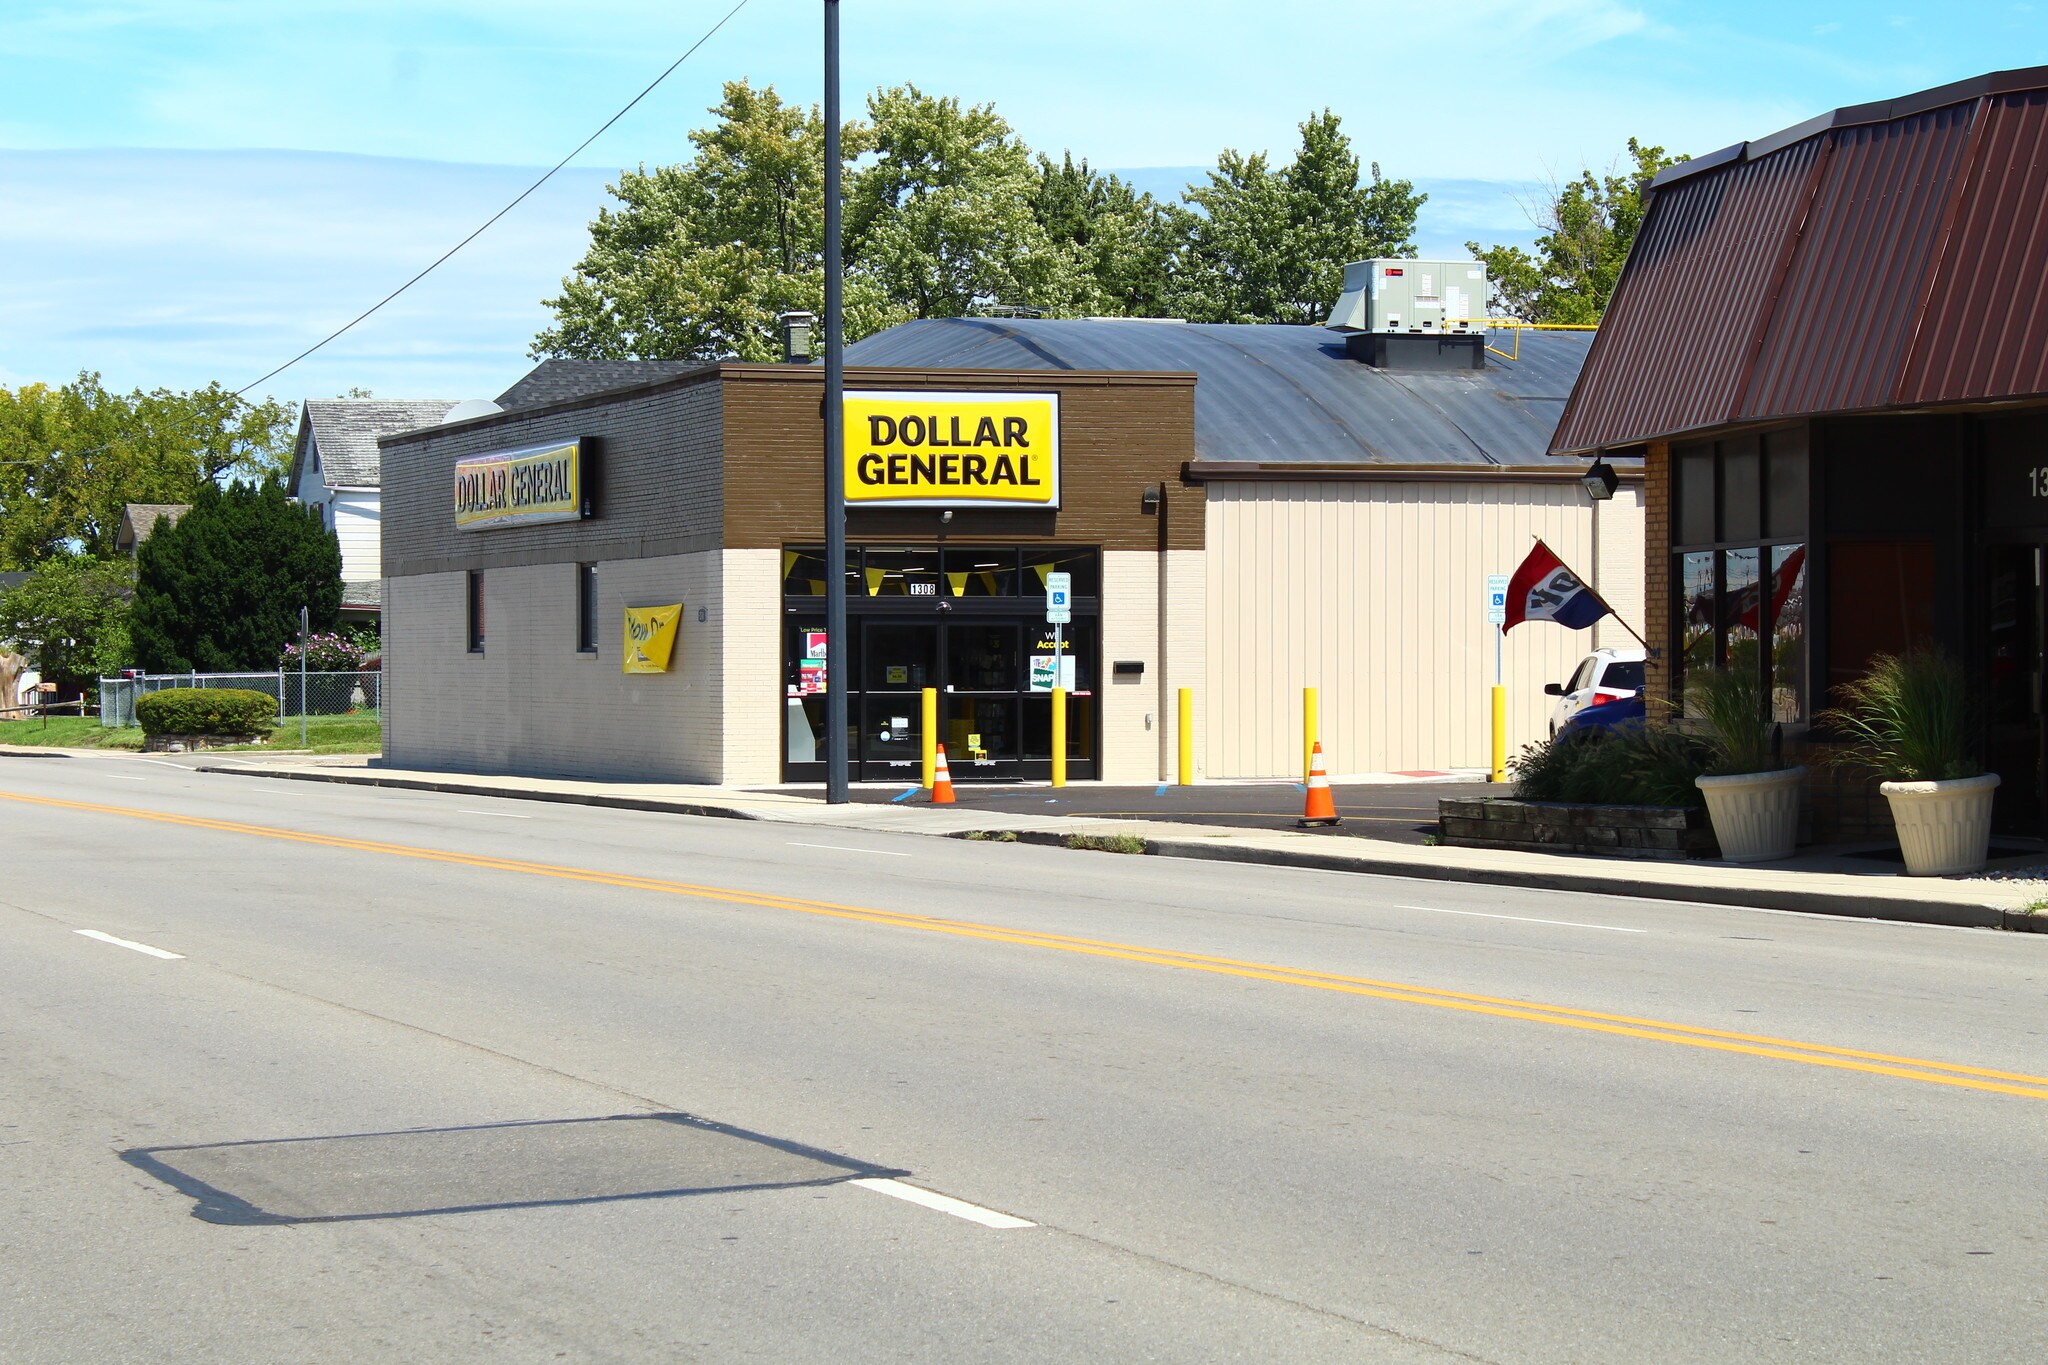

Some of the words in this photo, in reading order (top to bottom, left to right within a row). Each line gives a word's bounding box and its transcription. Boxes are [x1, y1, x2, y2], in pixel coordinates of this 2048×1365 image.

[867, 415, 1030, 447] DOLLAR
[857, 453, 1041, 486] GENERAL
[2029, 467, 2048, 497] 13
[457, 469, 507, 513] DOLLAR
[511, 459, 572, 507] GENERAL
[912, 584, 935, 595] 1308
[1044, 631, 1056, 640] W
[1032, 673, 1054, 683] SNAP
